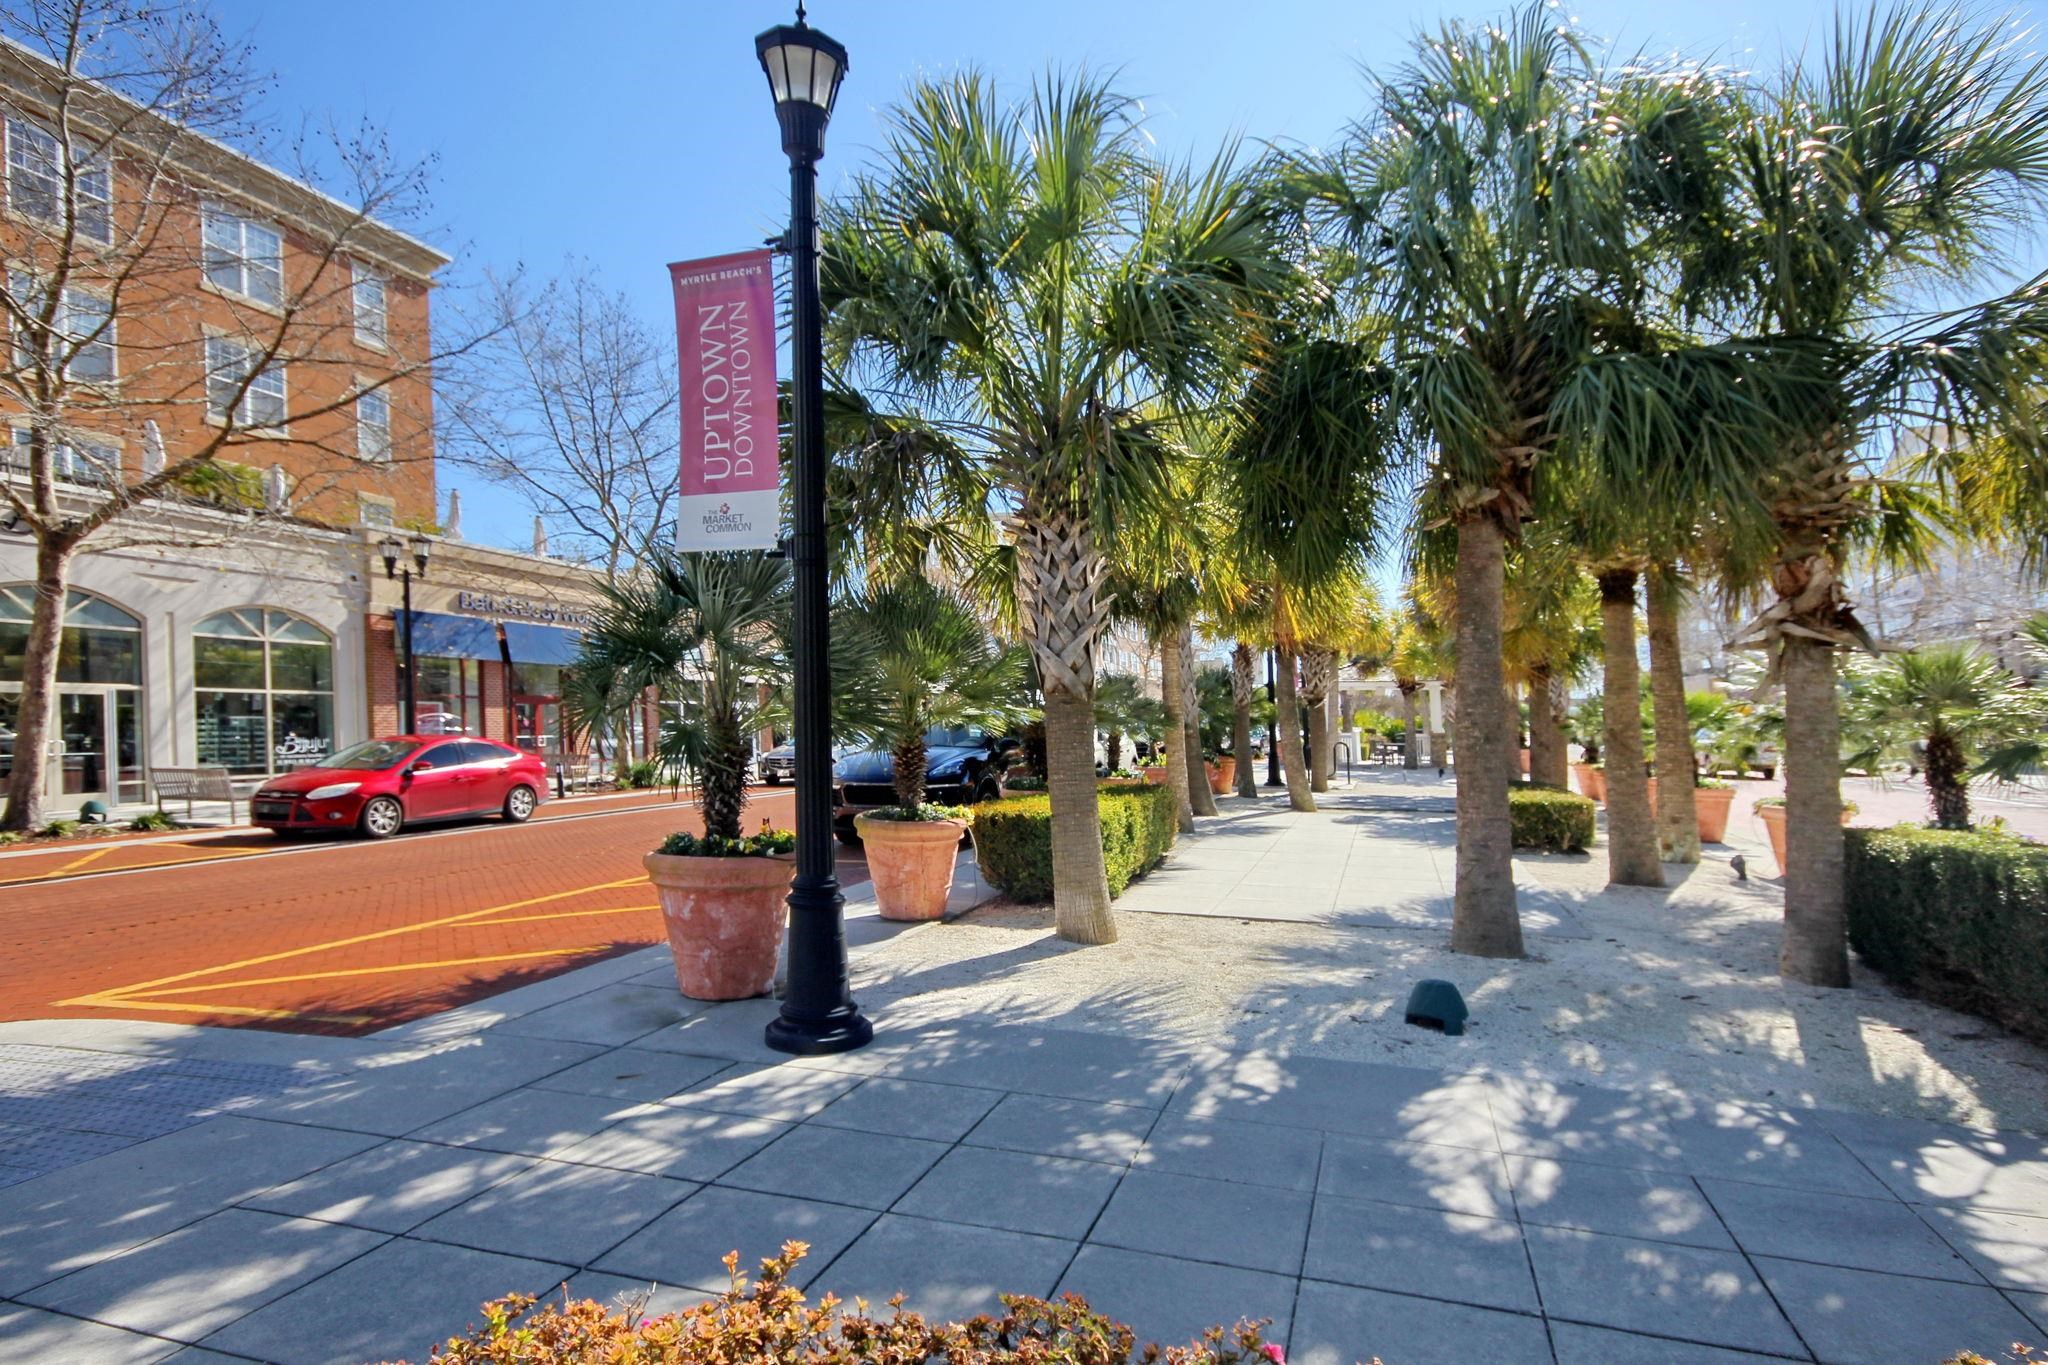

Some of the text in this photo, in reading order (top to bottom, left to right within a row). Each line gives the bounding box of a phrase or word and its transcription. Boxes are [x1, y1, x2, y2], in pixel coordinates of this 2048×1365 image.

[680, 265, 762, 286] MYRTLE BEACH'S
[698, 304, 731, 483] UPTOWN
[727, 300, 753, 477] DOWNTOWN
[702, 513, 744, 525] MARKET
[705, 522, 752, 534] COMMON
